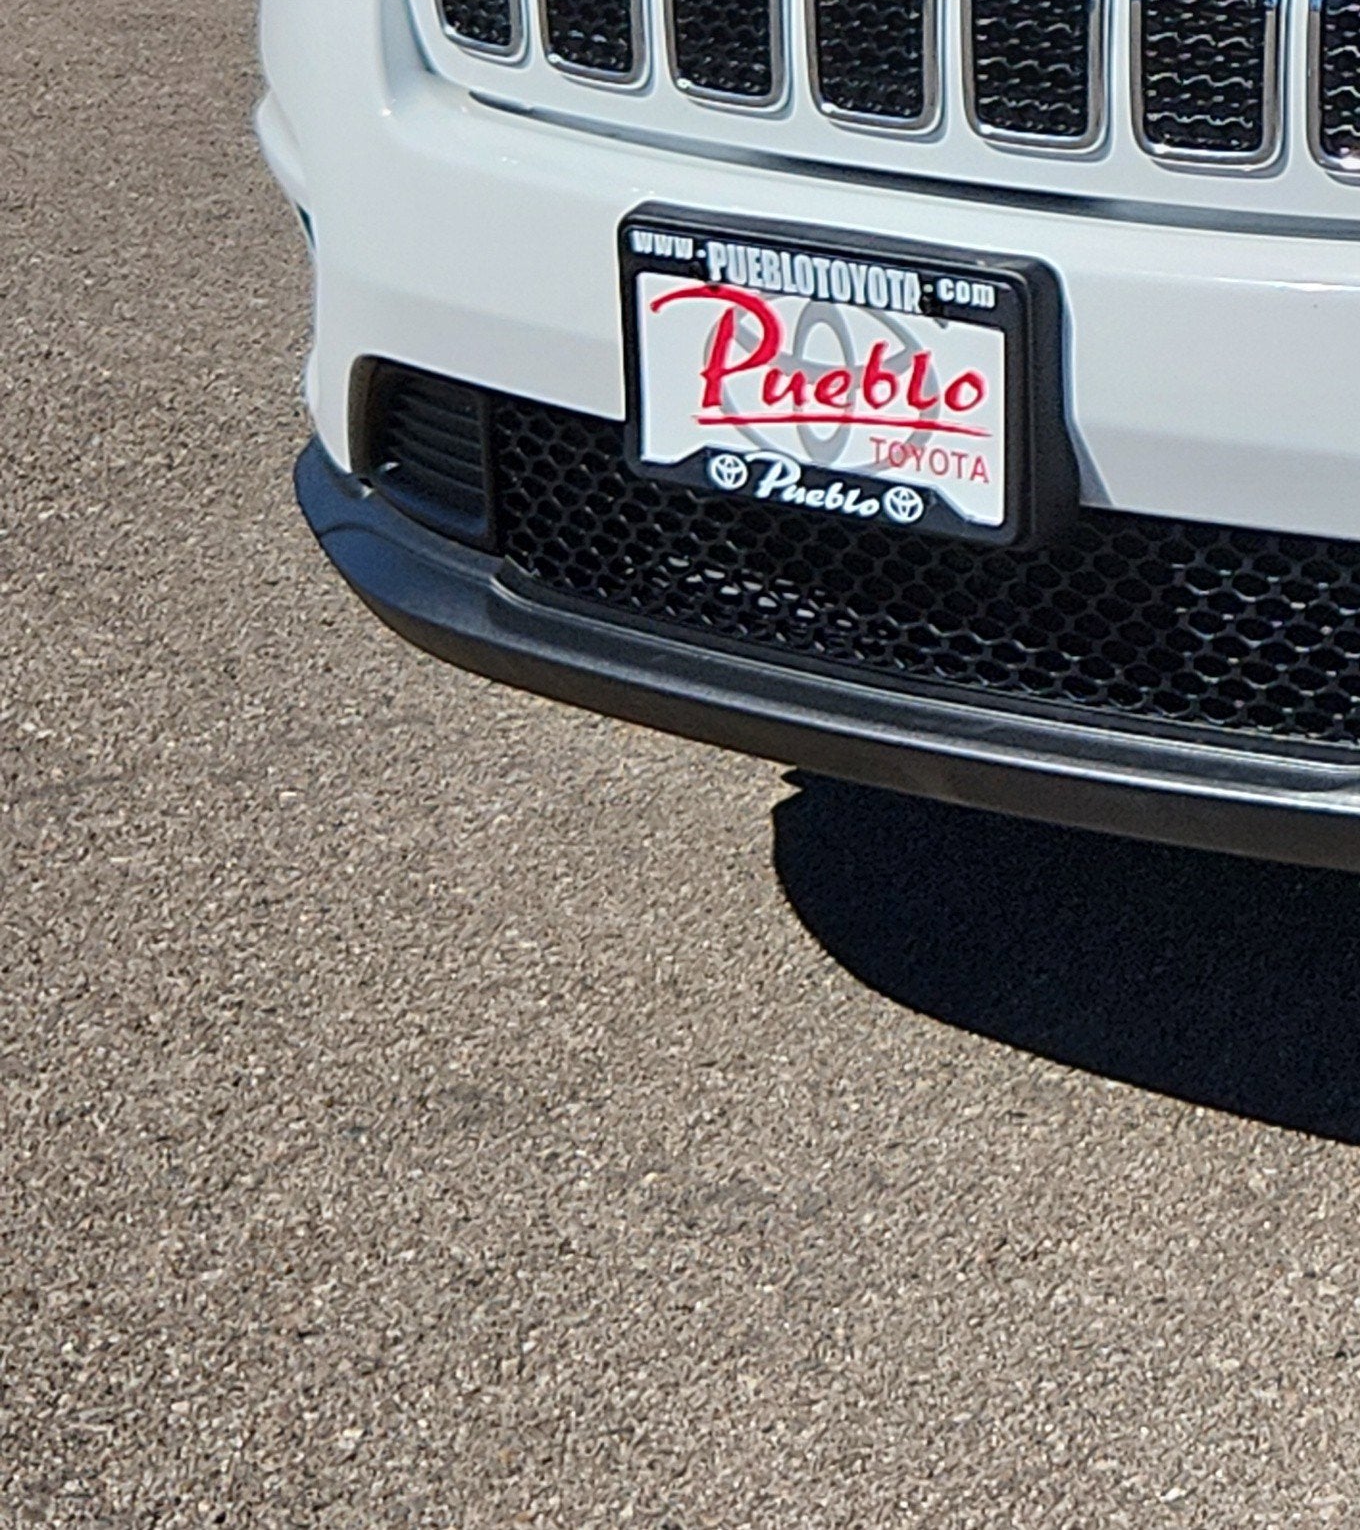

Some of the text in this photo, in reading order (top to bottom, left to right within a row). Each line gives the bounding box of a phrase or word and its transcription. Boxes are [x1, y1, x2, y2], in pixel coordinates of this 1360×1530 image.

[650, 283, 986, 412] Pueblo
[744, 451, 880, 517] Pueblo
[869, 436, 990, 484] TOYOTA
